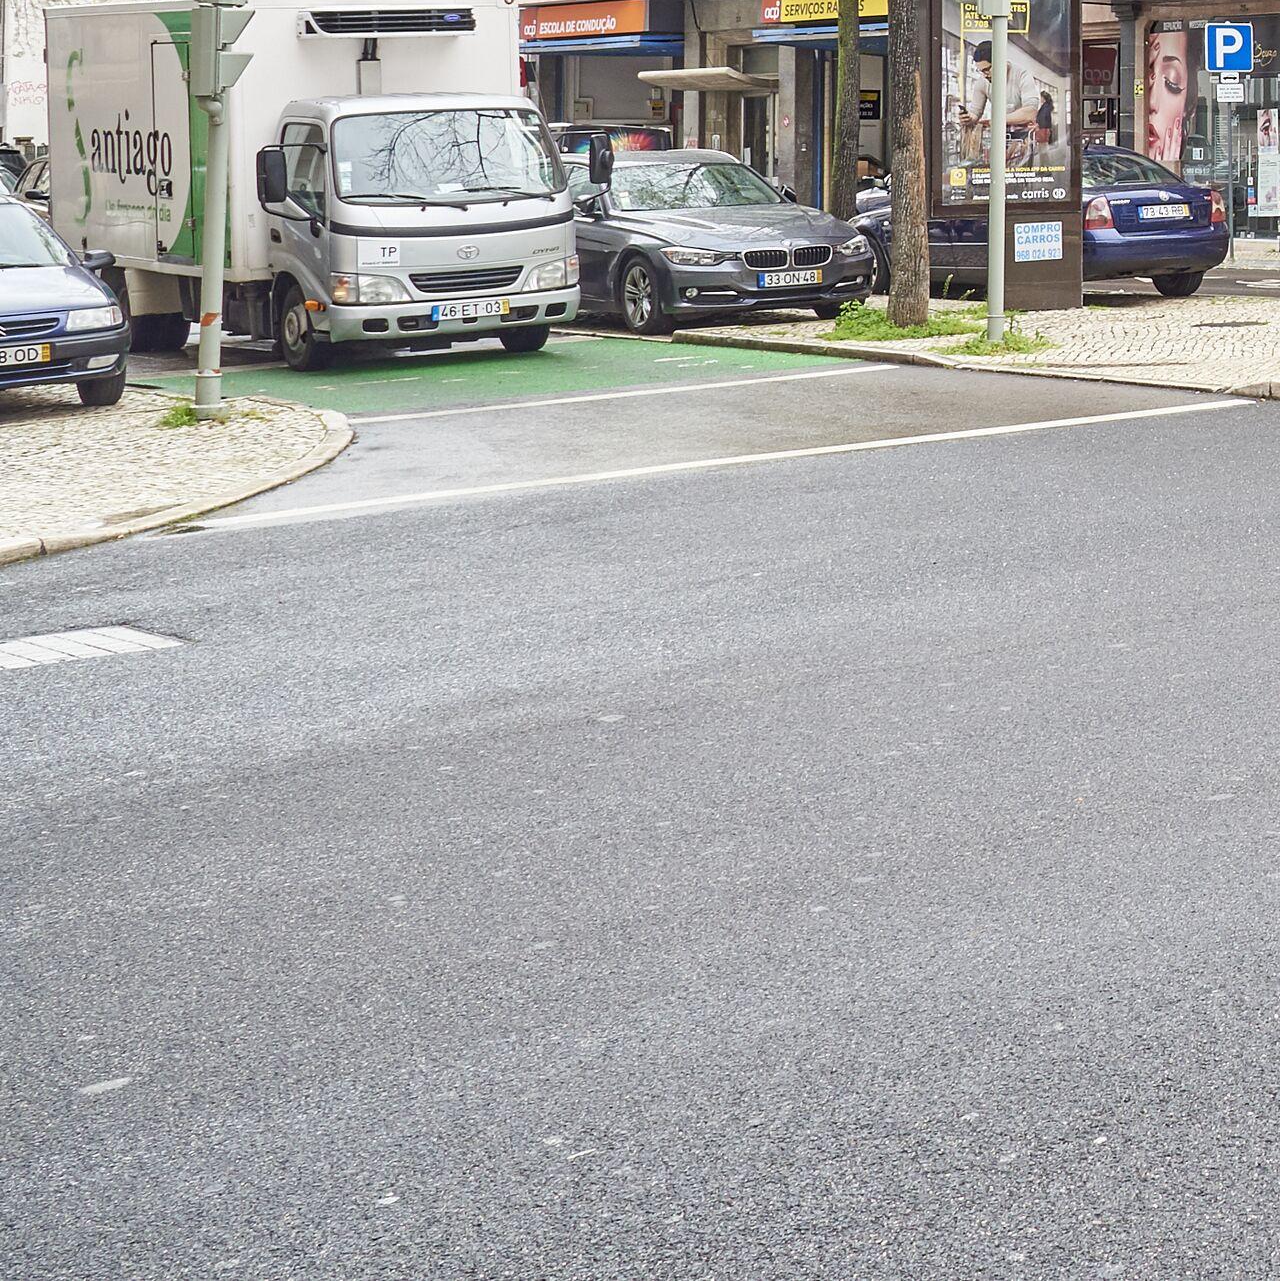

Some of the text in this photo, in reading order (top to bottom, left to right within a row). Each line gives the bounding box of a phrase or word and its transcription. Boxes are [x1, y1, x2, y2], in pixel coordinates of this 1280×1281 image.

[784, 2, 825, 18] SERVIÇOS
[539, 21, 565, 35] ESCOLA
[566, 20, 576, 32] DE
[576, 15, 617, 34] CONDUÇÃO
[1215, 27, 1244, 68] P
[1021, 188, 1049, 199] carris
[1015, 223, 1061, 234] COMPRO
[1017, 234, 1060, 245] CARROS
[381, 247, 397, 257] TP
